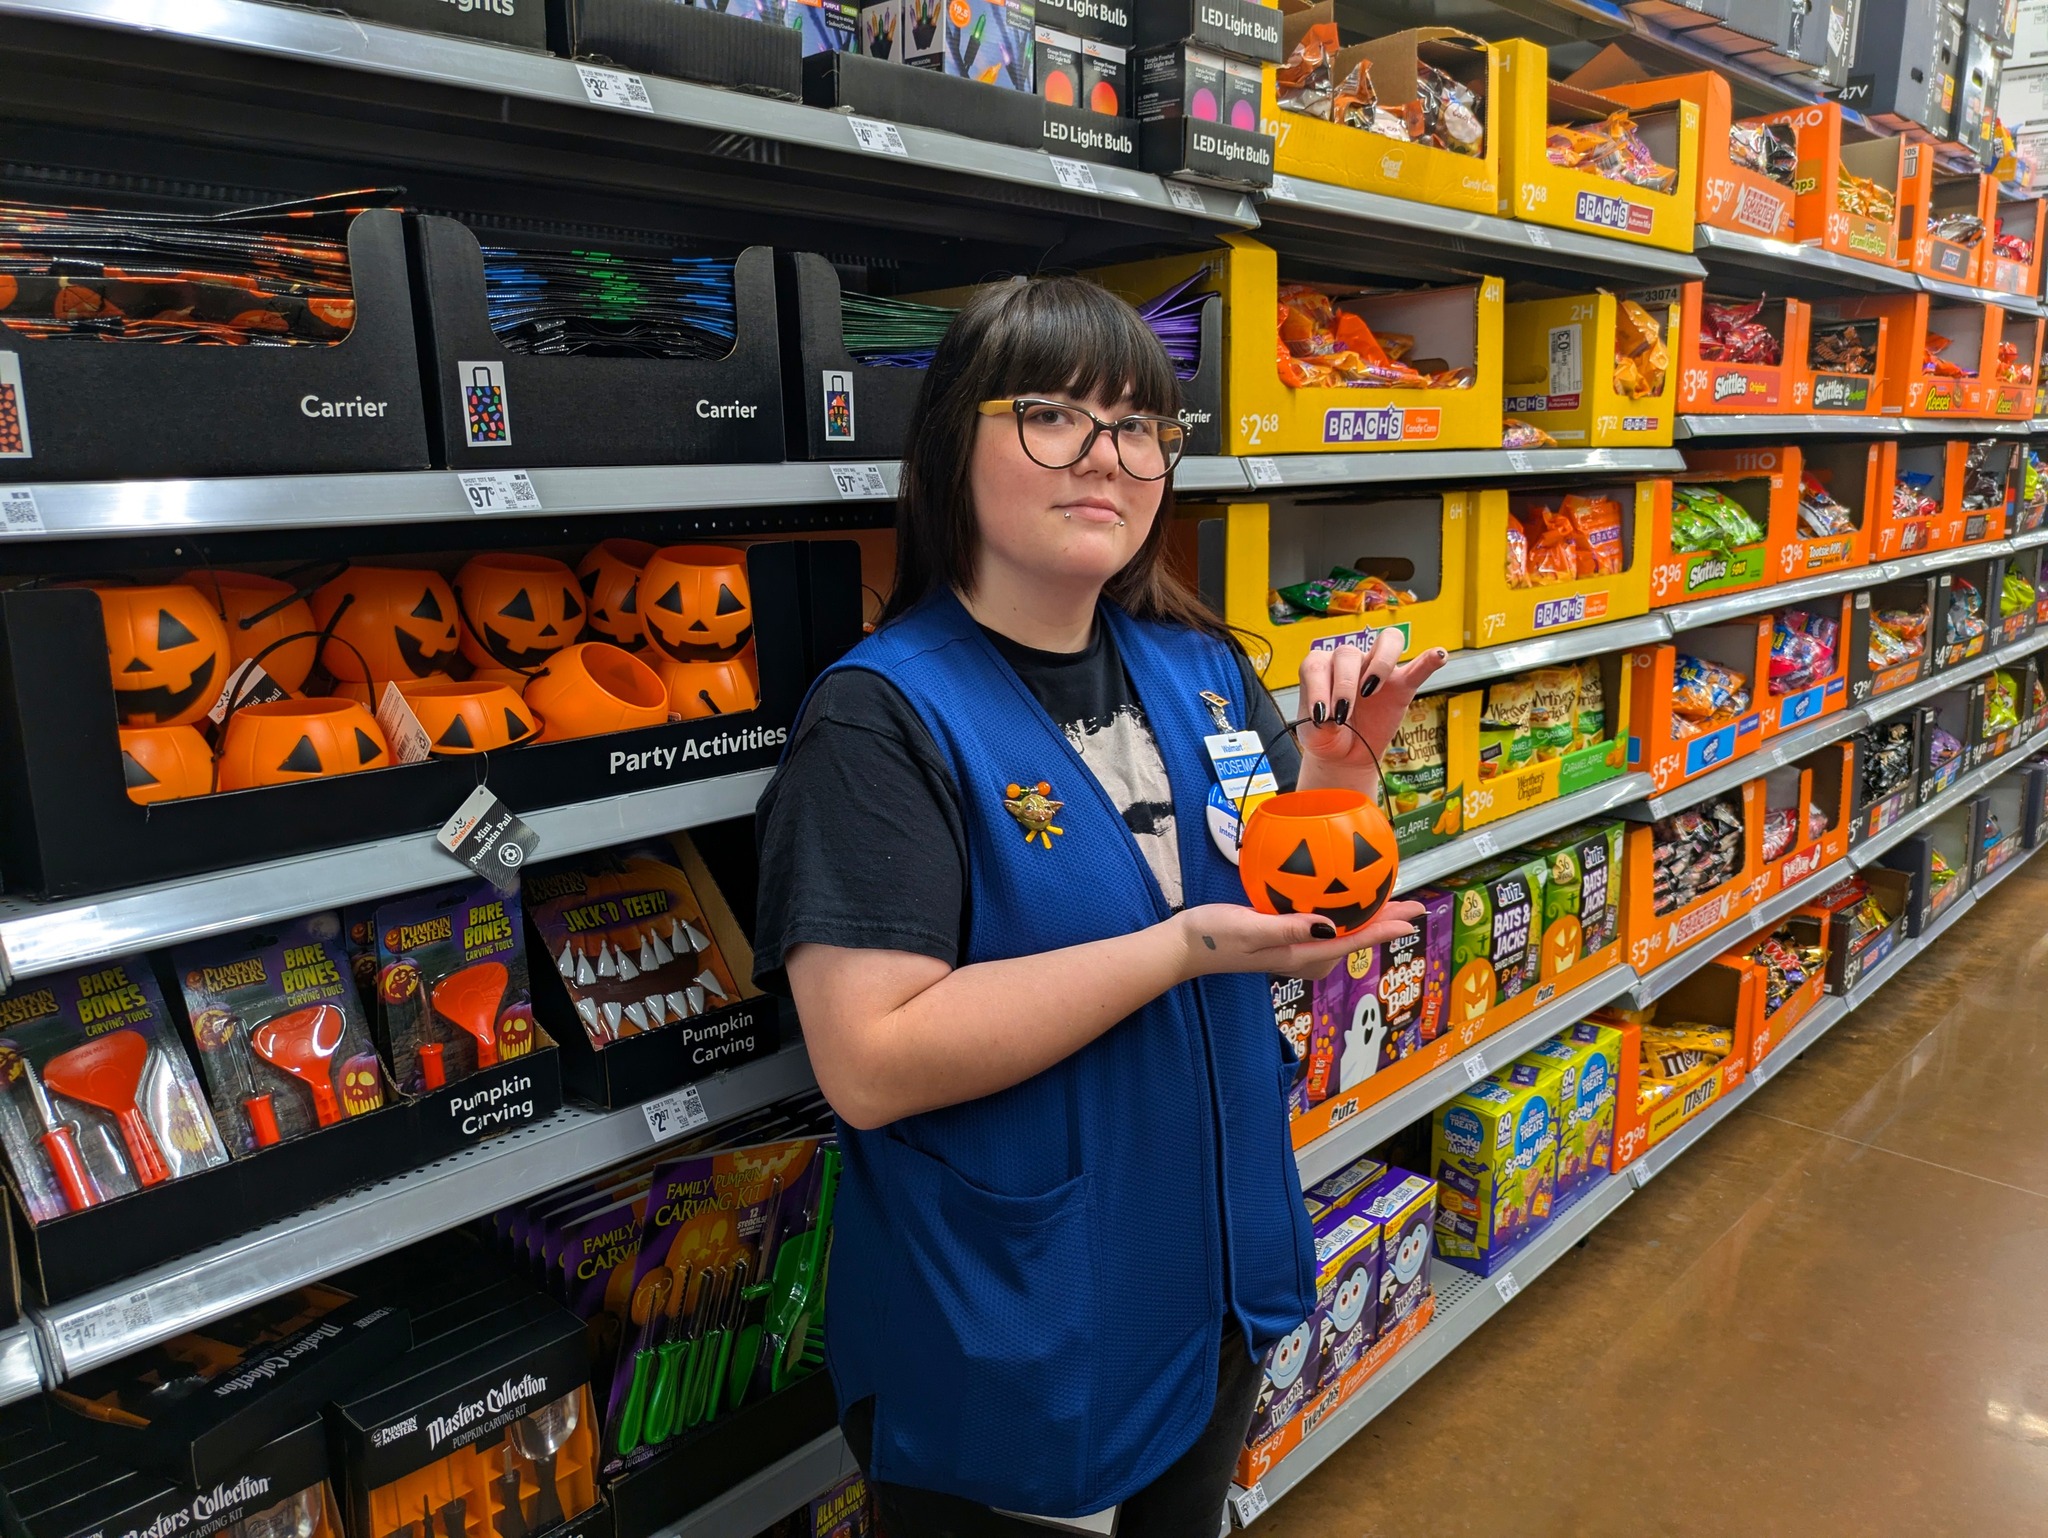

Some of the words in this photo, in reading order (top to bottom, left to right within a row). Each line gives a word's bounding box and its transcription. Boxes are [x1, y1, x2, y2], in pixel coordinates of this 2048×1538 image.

[1100, 4, 1127, 27] Bulb
[1201, 6, 1223, 28] LED
[1225, 13, 1253, 37] Light
[1254, 21, 1278, 44] Bulb
[1838, 84, 1868, 101] 47V
[1684, 111, 1696, 129] 5H
[1043, 120, 1068, 140] LED
[1070, 125, 1103, 151] Light
[1105, 135, 1133, 154] Bulb
[1193, 132, 1215, 153] LED
[1217, 138, 1245, 162] Light
[1246, 146, 1270, 166] Bulb
[1462, 176, 1479, 189] Candy
[1481, 180, 1495, 193] Corn
[1521, 183, 1547, 212] $268
[1706, 179, 1735, 213] $587
[1741, 195, 1776, 226] SMARTIES
[1828, 214, 1849, 245] $346
[1484, 285, 1500, 302] 4H
[1570, 304, 1594, 321] 2H
[1683, 370, 1708, 402] $396
[1714, 373, 1748, 402] Skittles
[1815, 382, 1844, 405] Skittles
[300, 395, 388, 418] Carrier
[695, 399, 757, 420] Carrier
[1178, 408, 1212, 424] Carrier
[1240, 414, 1279, 446] $268
[1329, 412, 1400, 440] BRACH'S
[1405, 422, 1422, 435] Candy
[1734, 453, 1776, 471] 1110
[1449, 504, 1463, 519] 6H
[1781, 545, 1803, 574] $396
[1652, 564, 1682, 597] $396
[1689, 560, 1727, 589] Skittles
[1483, 613, 1506, 639] $752
[610, 746, 677, 775] Party
[682, 726, 787, 762] Activities
[1222, 744, 1243, 753] Walmart
[1517, 771, 1545, 790] Werther's
[1652, 753, 1680, 790] $554
[1463, 789, 1493, 819] $396
[1517, 785, 1542, 802] Original
[451, 816, 478, 848] celebrate!
[469, 829, 501, 866] Pumpkin
[496, 813, 513, 832] Pail
[473, 821, 493, 843] Mini
[1407, 817, 1430, 837] APPLE
[1583, 869, 1602, 897] BATS
[1602, 866, 1608, 885] &
[1751, 871, 1771, 902] $587
[469, 901, 504, 927] BARE
[562, 901, 621, 933] JACK'D
[623, 890, 669, 920] TEETH
[1464, 906, 1483, 919] BAGS
[1466, 893, 1478, 909] 36
[1581, 888, 1606, 918] JACKS
[400, 915, 451, 942] PUMPKIN
[464, 917, 513, 949] BONES
[1493, 908, 1521, 937] BATS
[1522, 904, 1530, 925] &
[401, 925, 453, 951] MASTERS
[465, 944, 494, 962] CARVING
[494, 938, 514, 952] TOOLS
[1493, 927, 1528, 960] JACKS
[1632, 932, 1662, 968] $346
[283, 943, 326, 970] BARE
[1351, 959, 1369, 974] BAGS
[1394, 949, 1414, 968] Mini
[78, 966, 129, 997] BARE
[203, 958, 264, 985] PUMPKIN
[207, 968, 267, 993] MASTERS
[281, 960, 340, 994] BONES
[1380, 959, 1425, 997] Cheese
[77, 984, 147, 1024] BONES
[287, 991, 322, 1007] CARVING
[322, 984, 345, 998] TOOLS
[1387, 983, 1421, 1016] Balls
[85, 1018, 125, 1037] CARVING
[126, 1008, 153, 1025] TOOLS
[682, 1012, 754, 1046] Pumpkin
[1275, 1004, 1297, 1025] Mini
[1460, 1018, 1485, 1045] $697
[692, 1034, 755, 1066] Carving
[1563, 1068, 1574, 1085] 60
[1582, 1074, 1603, 1096] TREATS
[1727, 1070, 1738, 1085] Size
[451, 1075, 531, 1117] Pumpkin
[1568, 1102, 1594, 1129] Spooky
[1595, 1086, 1614, 1106] Minis
[461, 1099, 534, 1135] Carving
[650, 1109, 670, 1133] $297
[1450, 1119, 1478, 1134] TREATS
[1498, 1114, 1512, 1133] 60
[1520, 1118, 1543, 1143] TREATS
[1654, 1107, 1680, 1132] peanut
[1444, 1129, 1481, 1151] Spooky
[1448, 1143, 1475, 1158] Minis
[1505, 1149, 1532, 1178] Spooky
[1533, 1131, 1554, 1155] Minis
[1618, 1122, 1646, 1162] $396
[666, 1176, 713, 1200] FAMILY
[714, 1167, 762, 1191] PUMPKIN
[655, 1192, 733, 1227] CARVING
[735, 1183, 763, 1210] KIT
[750, 1207, 759, 1218] 12
[583, 1220, 637, 1254] FAMILY
[1396, 1278, 1421, 1315] Welch's
[63, 1323, 97, 1351] $147
[284, 1322, 343, 1358] Masters
[1335, 1323, 1361, 1366] Welch's
[213, 1356, 290, 1397] Collection
[425, 1401, 486, 1451] Masters
[486, 1374, 546, 1413] Collection
[1272, 1380, 1303, 1424] Welch's
[1304, 1385, 1339, 1434] Welch's
[382, 1414, 417, 1440] PUMPKIN
[382, 1424, 418, 1446] MASTERS
[452, 1426, 483, 1449] PUMPKIN
[484, 1411, 514, 1434] CARVING
[514, 1403, 528, 1419] KIT
[1251, 1430, 1286, 1480] $587
[122, 1508, 190, 1538] asters
[192, 1476, 269, 1520] Collection
[229, 1507, 244, 1522] KIT
[817, 1502, 834, 1525] ALL
[834, 1495, 845, 1515] IN
[844, 1480, 867, 1502] ONE
